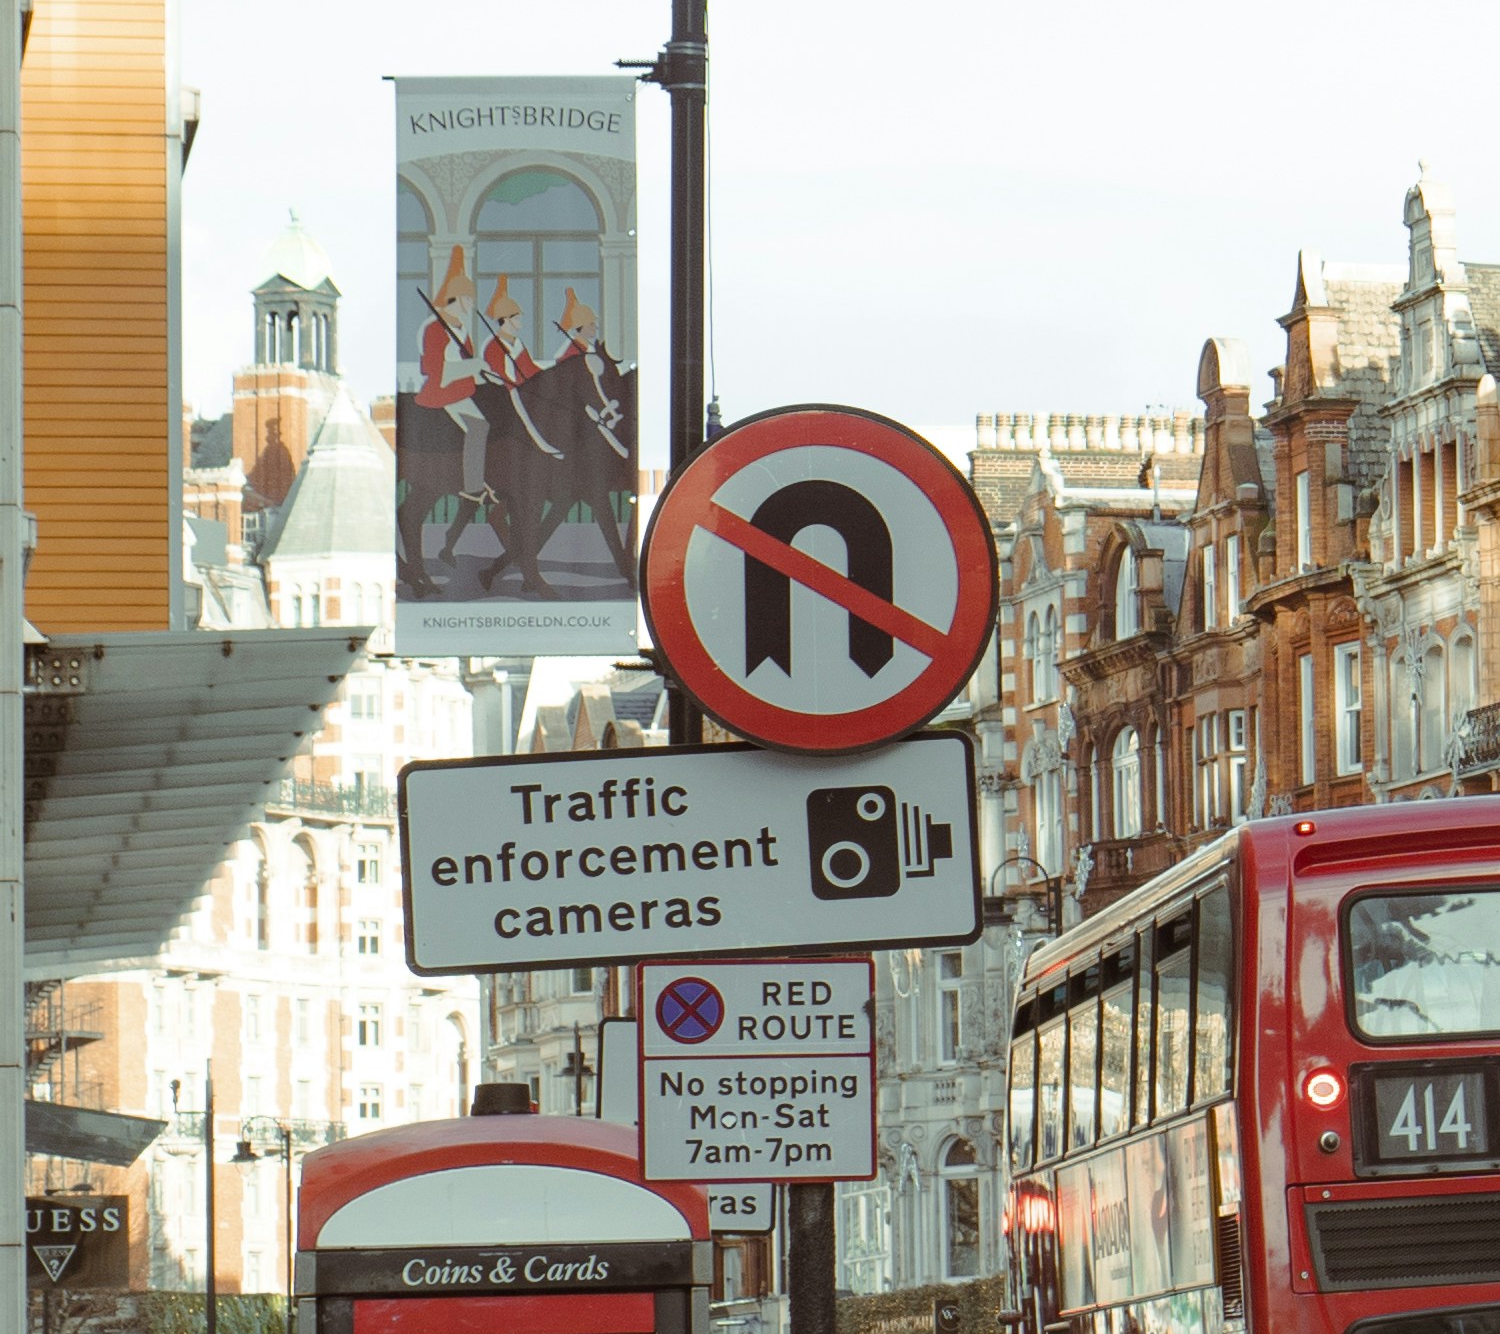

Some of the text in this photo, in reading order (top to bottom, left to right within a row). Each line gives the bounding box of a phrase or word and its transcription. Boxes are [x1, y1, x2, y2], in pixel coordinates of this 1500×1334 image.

[410, 105, 622, 134] KNIGHTSBRIDGE
[422, 616, 611, 628] KNIGHTSBRIDGELDN.CO.UK
[511, 777, 688, 824] Traffic
[431, 826, 779, 886] enforcement
[494, 896, 722, 939] cameras
[762, 981, 832, 1006] RED
[738, 1014, 856, 1040] ROUTE
[660, 1070, 858, 1099] No stopping
[690, 1103, 830, 1130] Mon-Sat
[1389, 1082, 1472, 1152] 414
[685, 1138, 832, 1167] 7am-7pm
[26, 1208, 120, 1233] UESS
[402, 1255, 610, 1286] Coins & Cards
